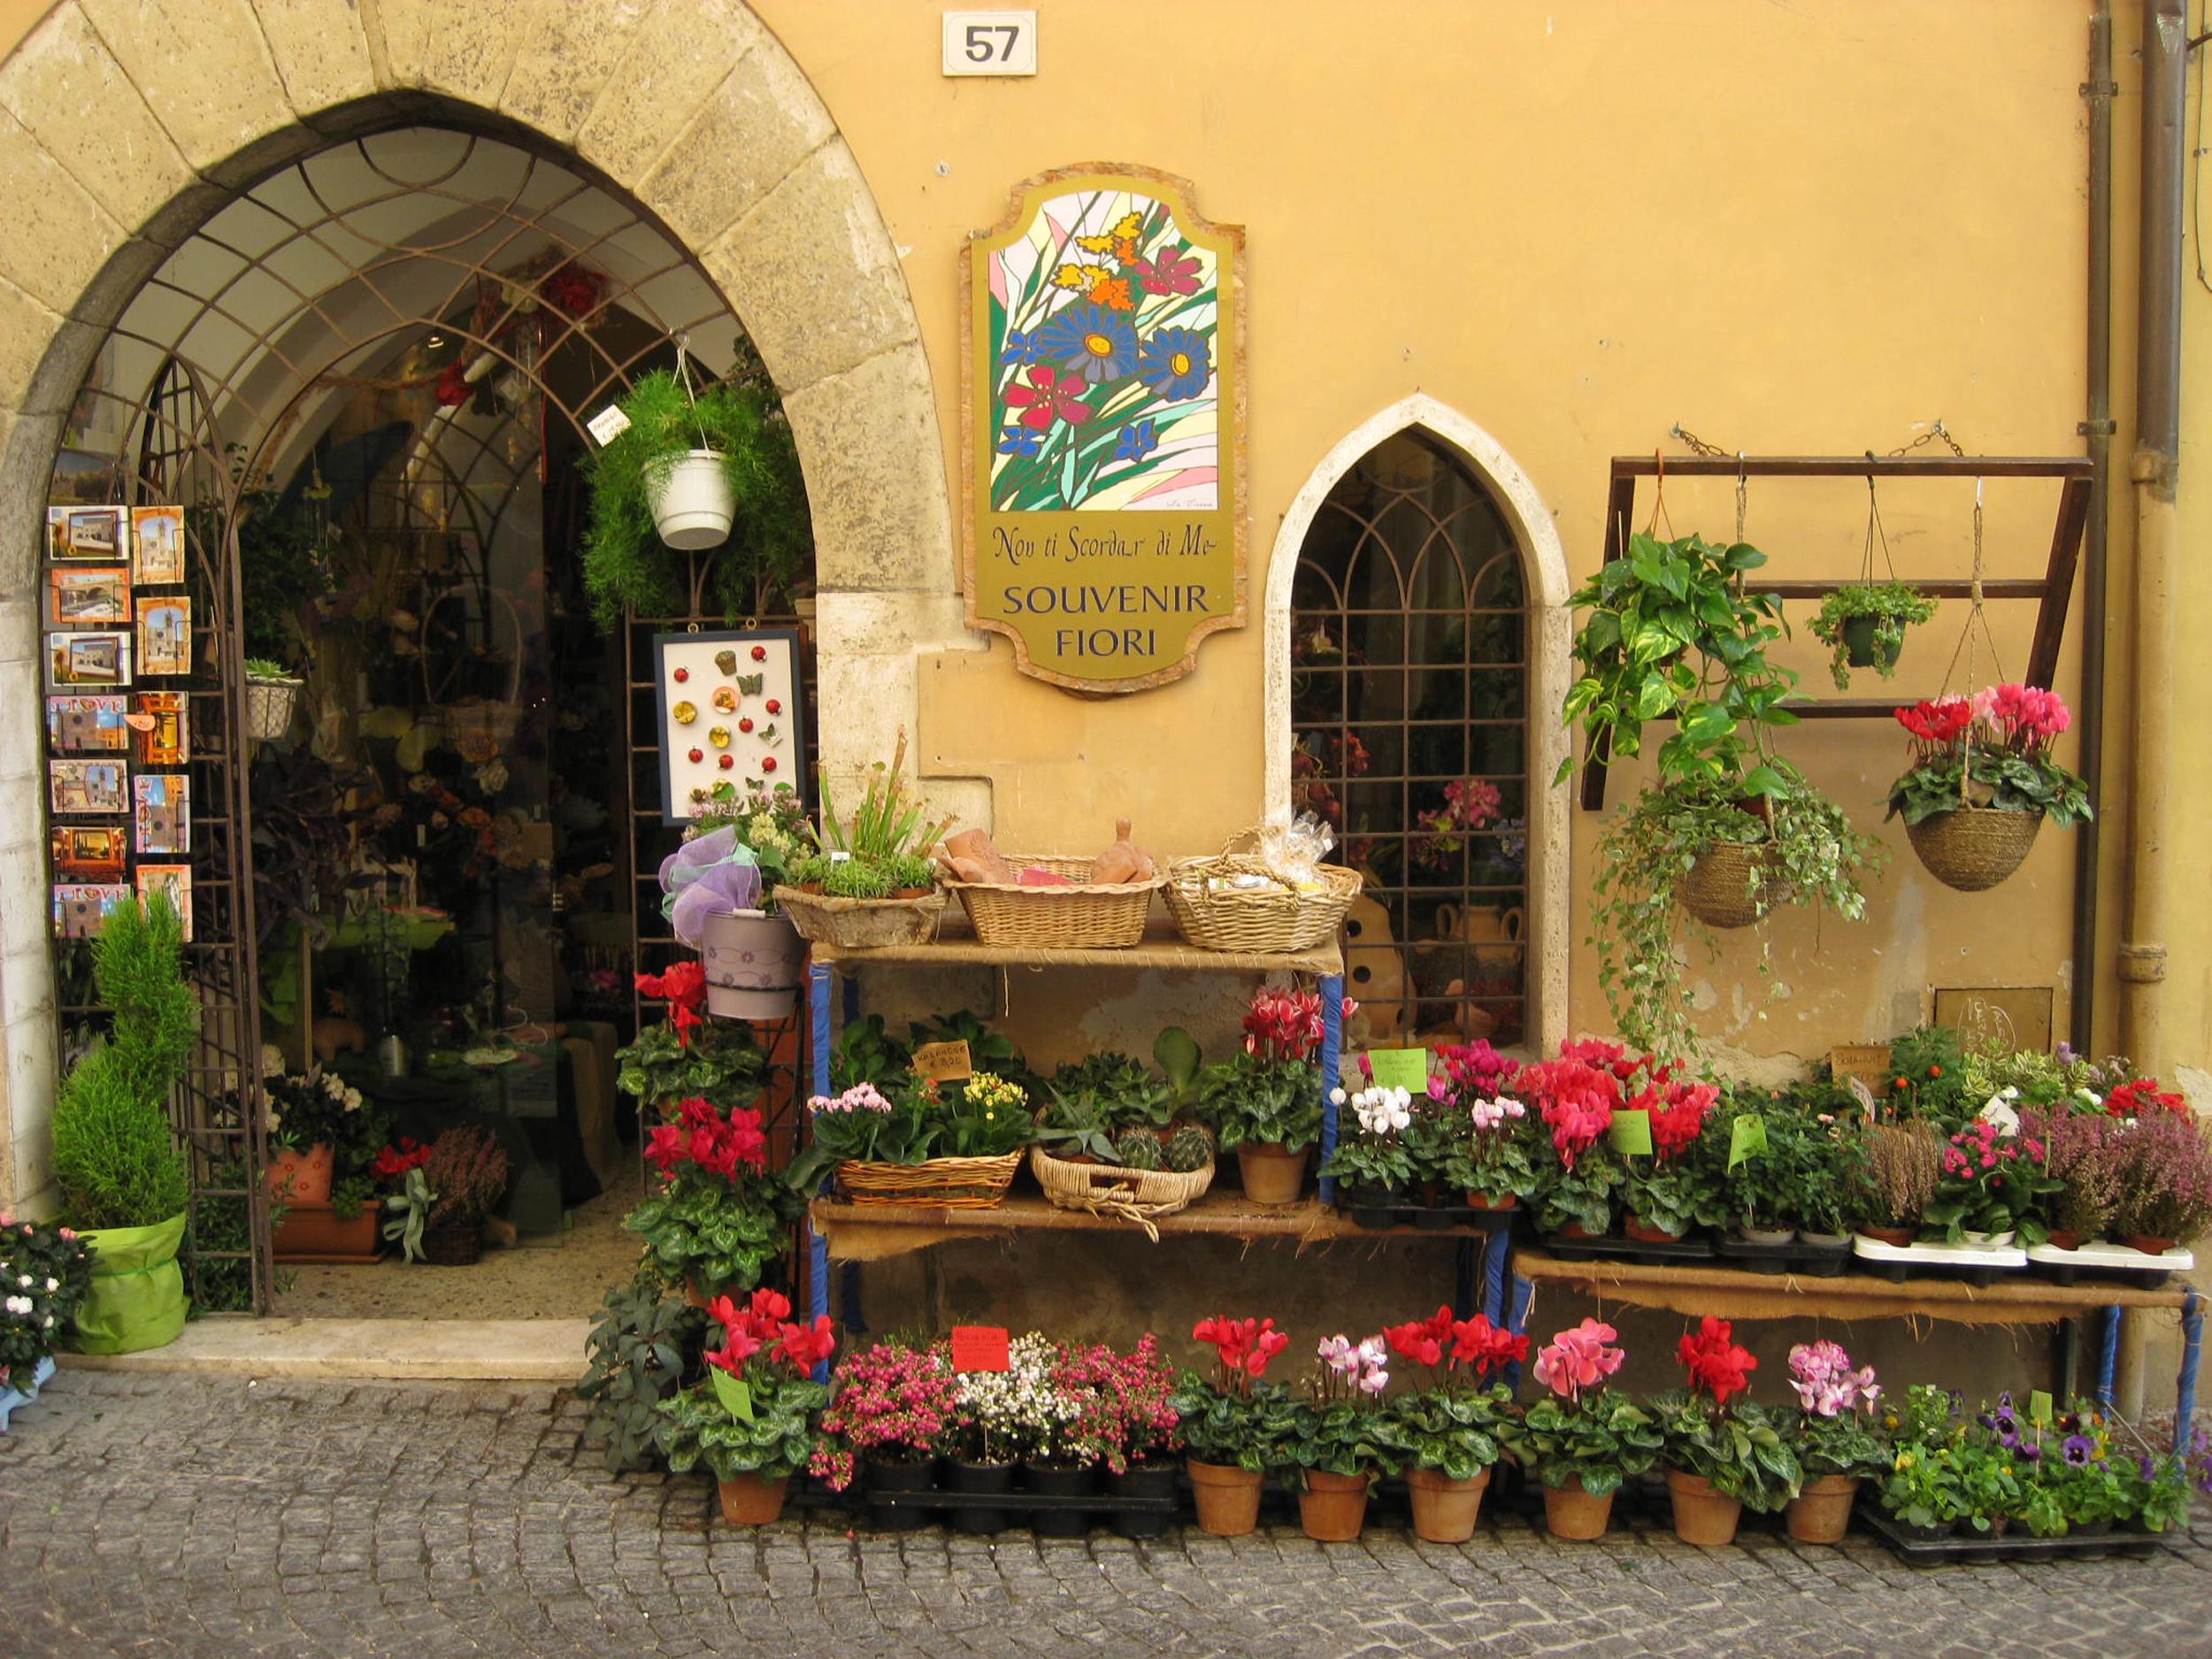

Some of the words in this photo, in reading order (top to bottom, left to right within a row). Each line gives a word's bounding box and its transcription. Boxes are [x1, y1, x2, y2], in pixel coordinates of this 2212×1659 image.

[965, 26, 1019, 62] 57
[993, 526, 1034, 565] Non
[1044, 533, 1057, 557] ti
[1064, 526, 1146, 562] Scordar
[1156, 529, 1171, 557] di
[1179, 524, 1217, 556] Me
[1003, 585, 1210, 614] SOUVENIR
[1056, 629, 1156, 657] FIORI
